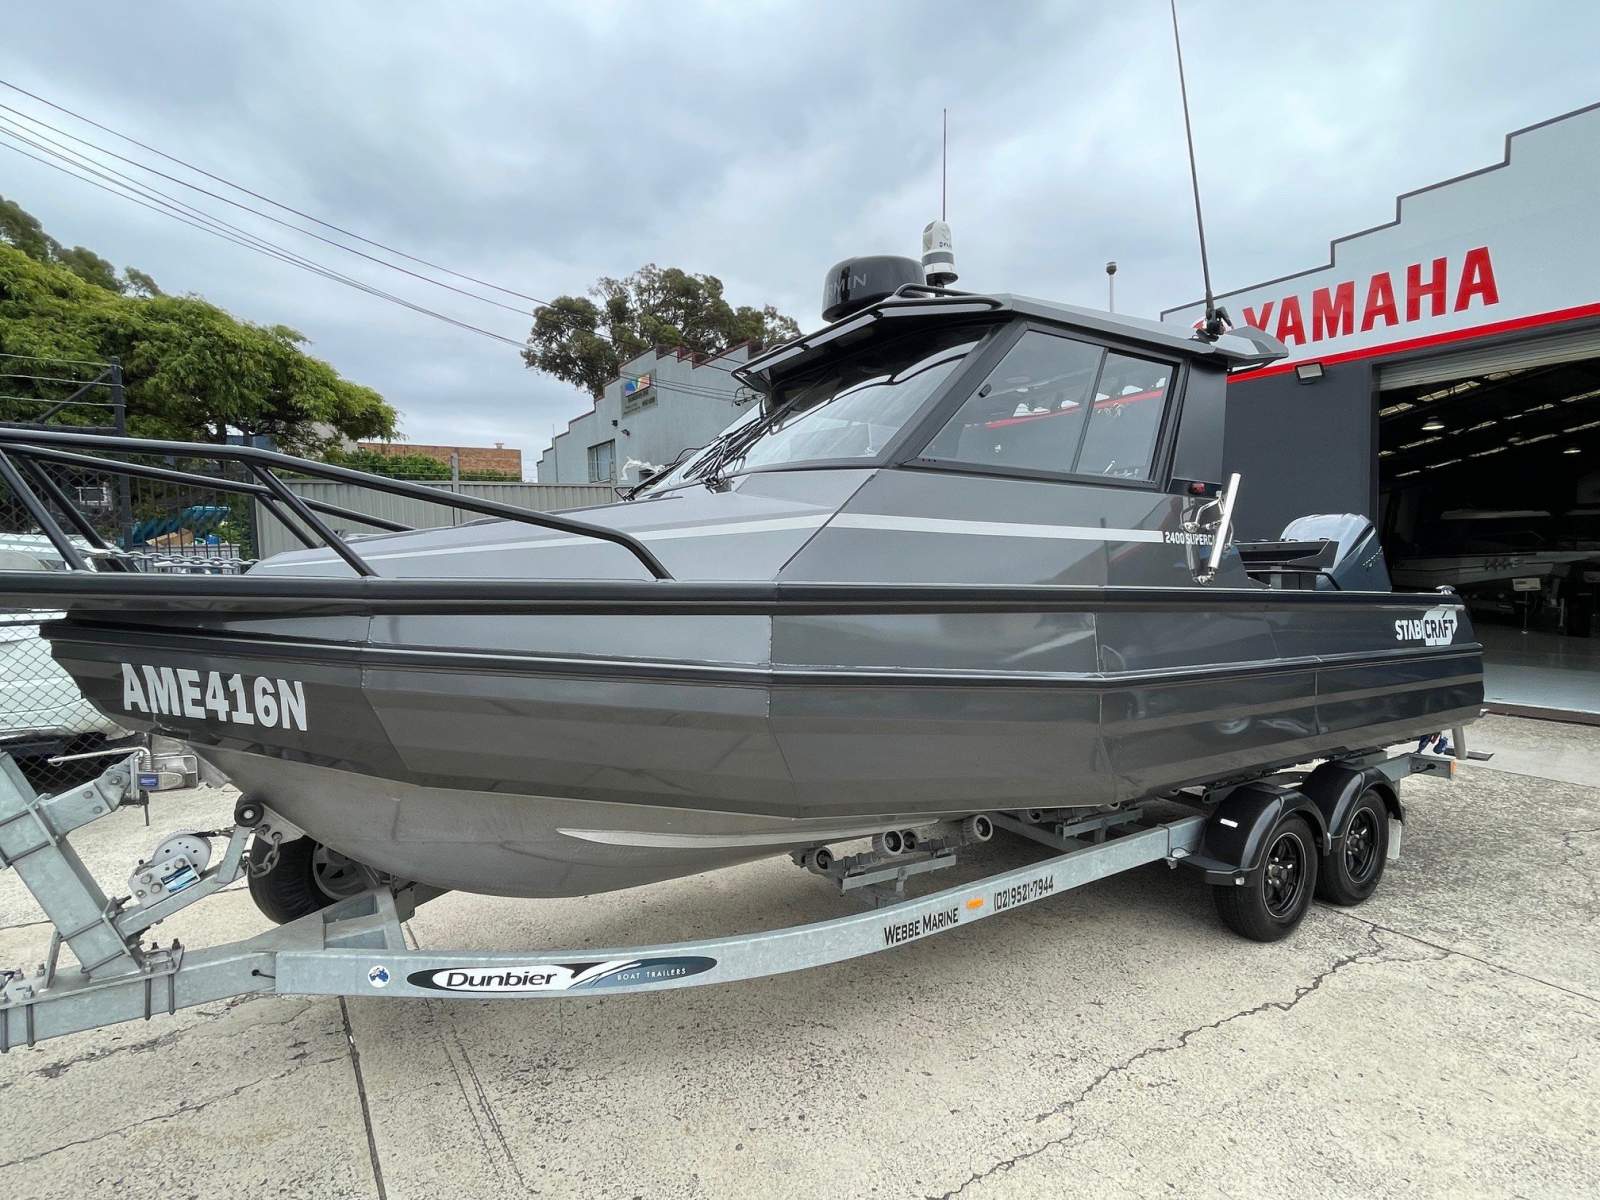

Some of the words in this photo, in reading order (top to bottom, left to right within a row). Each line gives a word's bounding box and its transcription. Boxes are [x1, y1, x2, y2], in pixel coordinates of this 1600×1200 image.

[1242, 246, 1500, 346] YAMAHA
[1165, 531, 1185, 545] 2400
[1185, 533, 1215, 546] SUPERC
[121, 662, 308, 731] AME416N
[446, 971, 557, 987] Dunbier
[646, 967, 686, 978] TRAILERS
